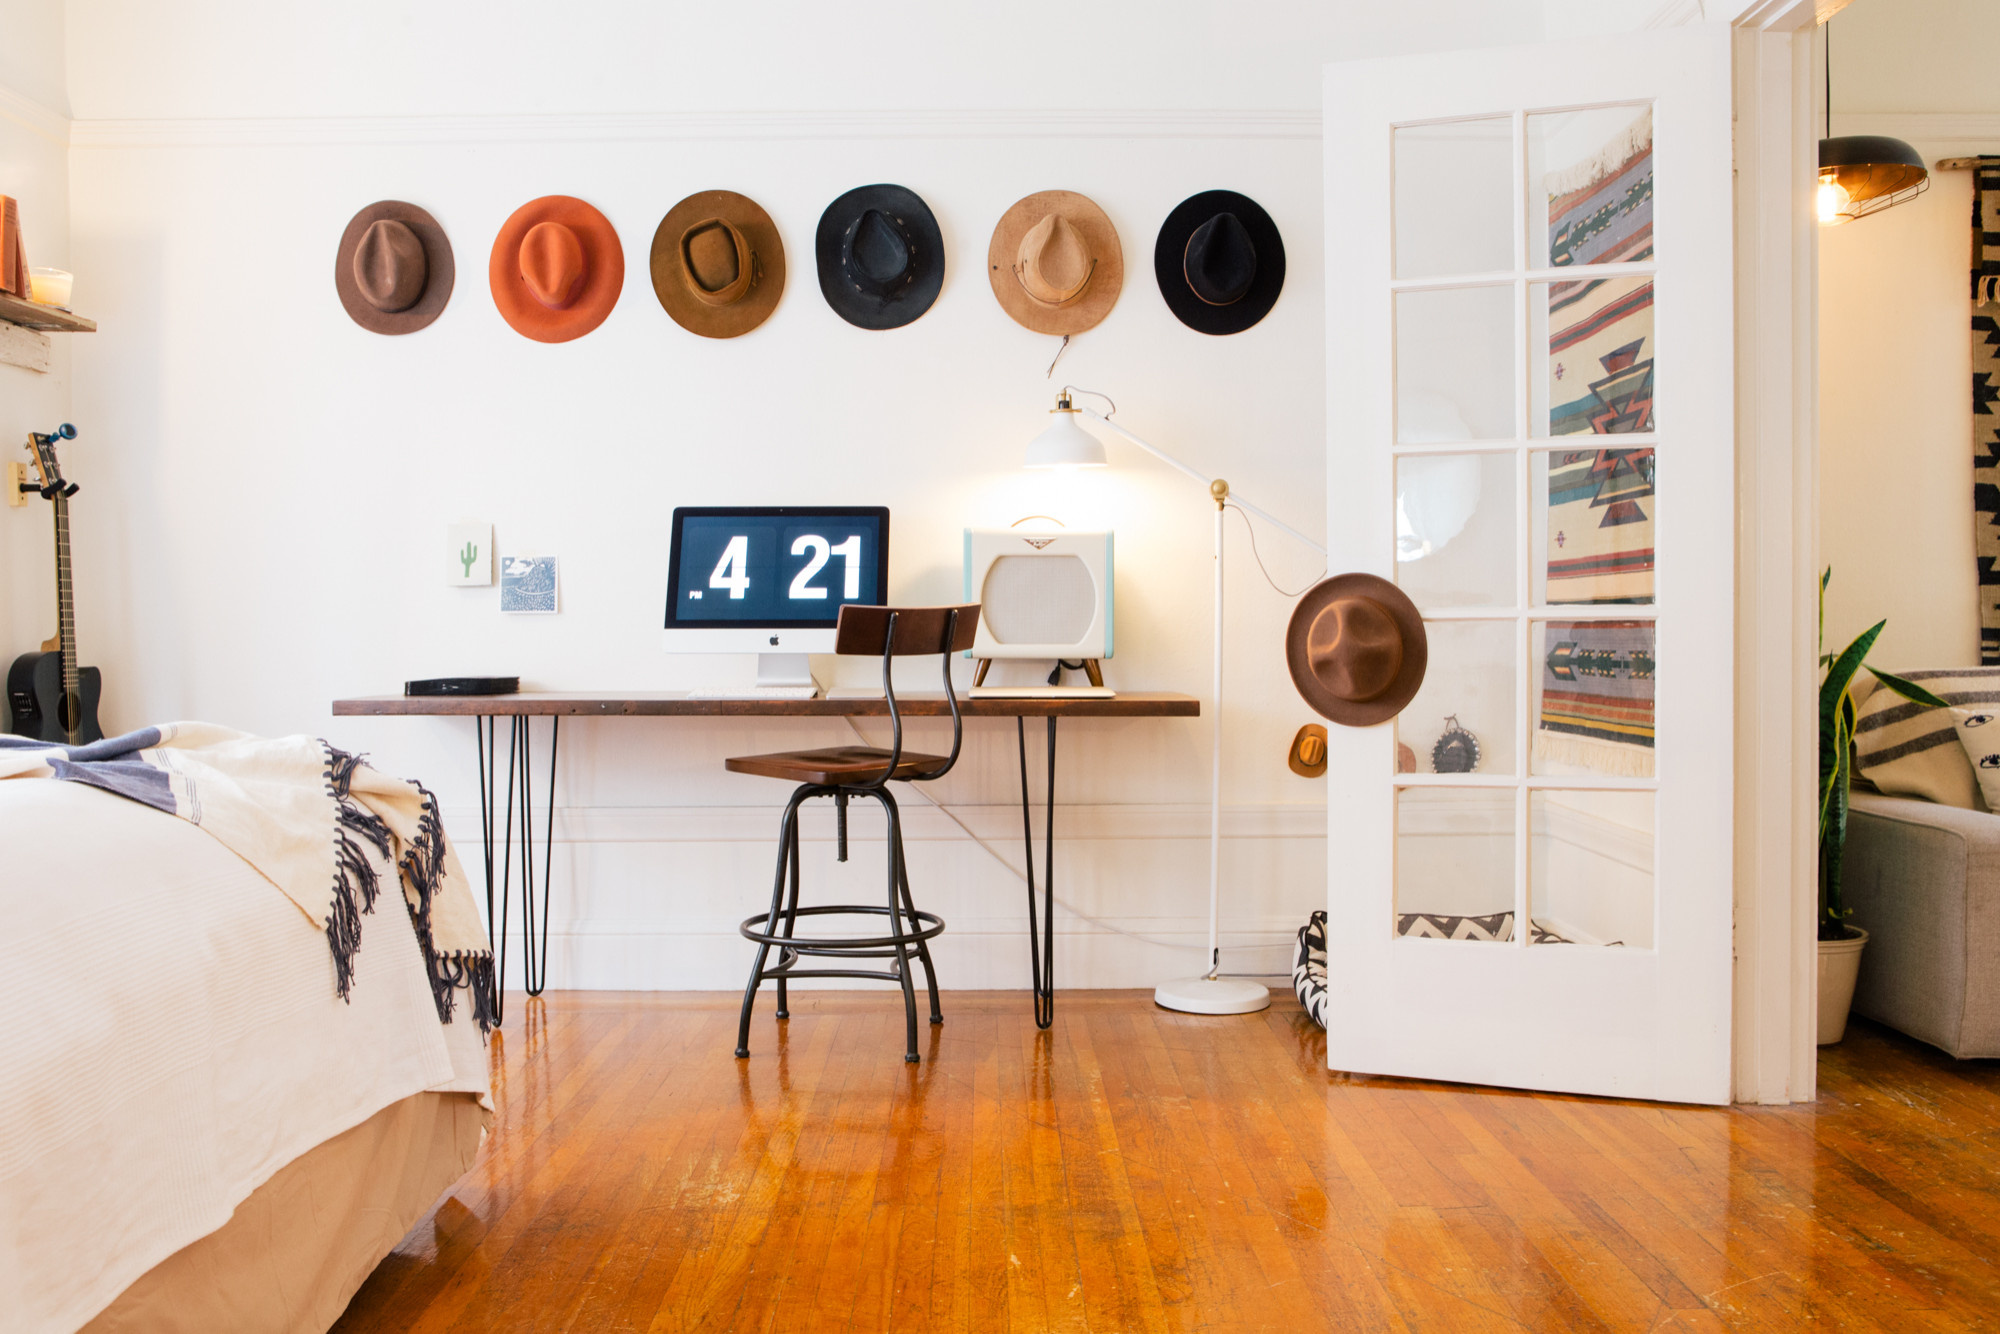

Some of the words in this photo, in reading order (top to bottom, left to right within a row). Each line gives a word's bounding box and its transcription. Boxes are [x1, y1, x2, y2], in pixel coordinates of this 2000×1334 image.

[689, 590, 703, 600] PM
[708, 535, 751, 600] 4
[788, 534, 862, 600] 21
